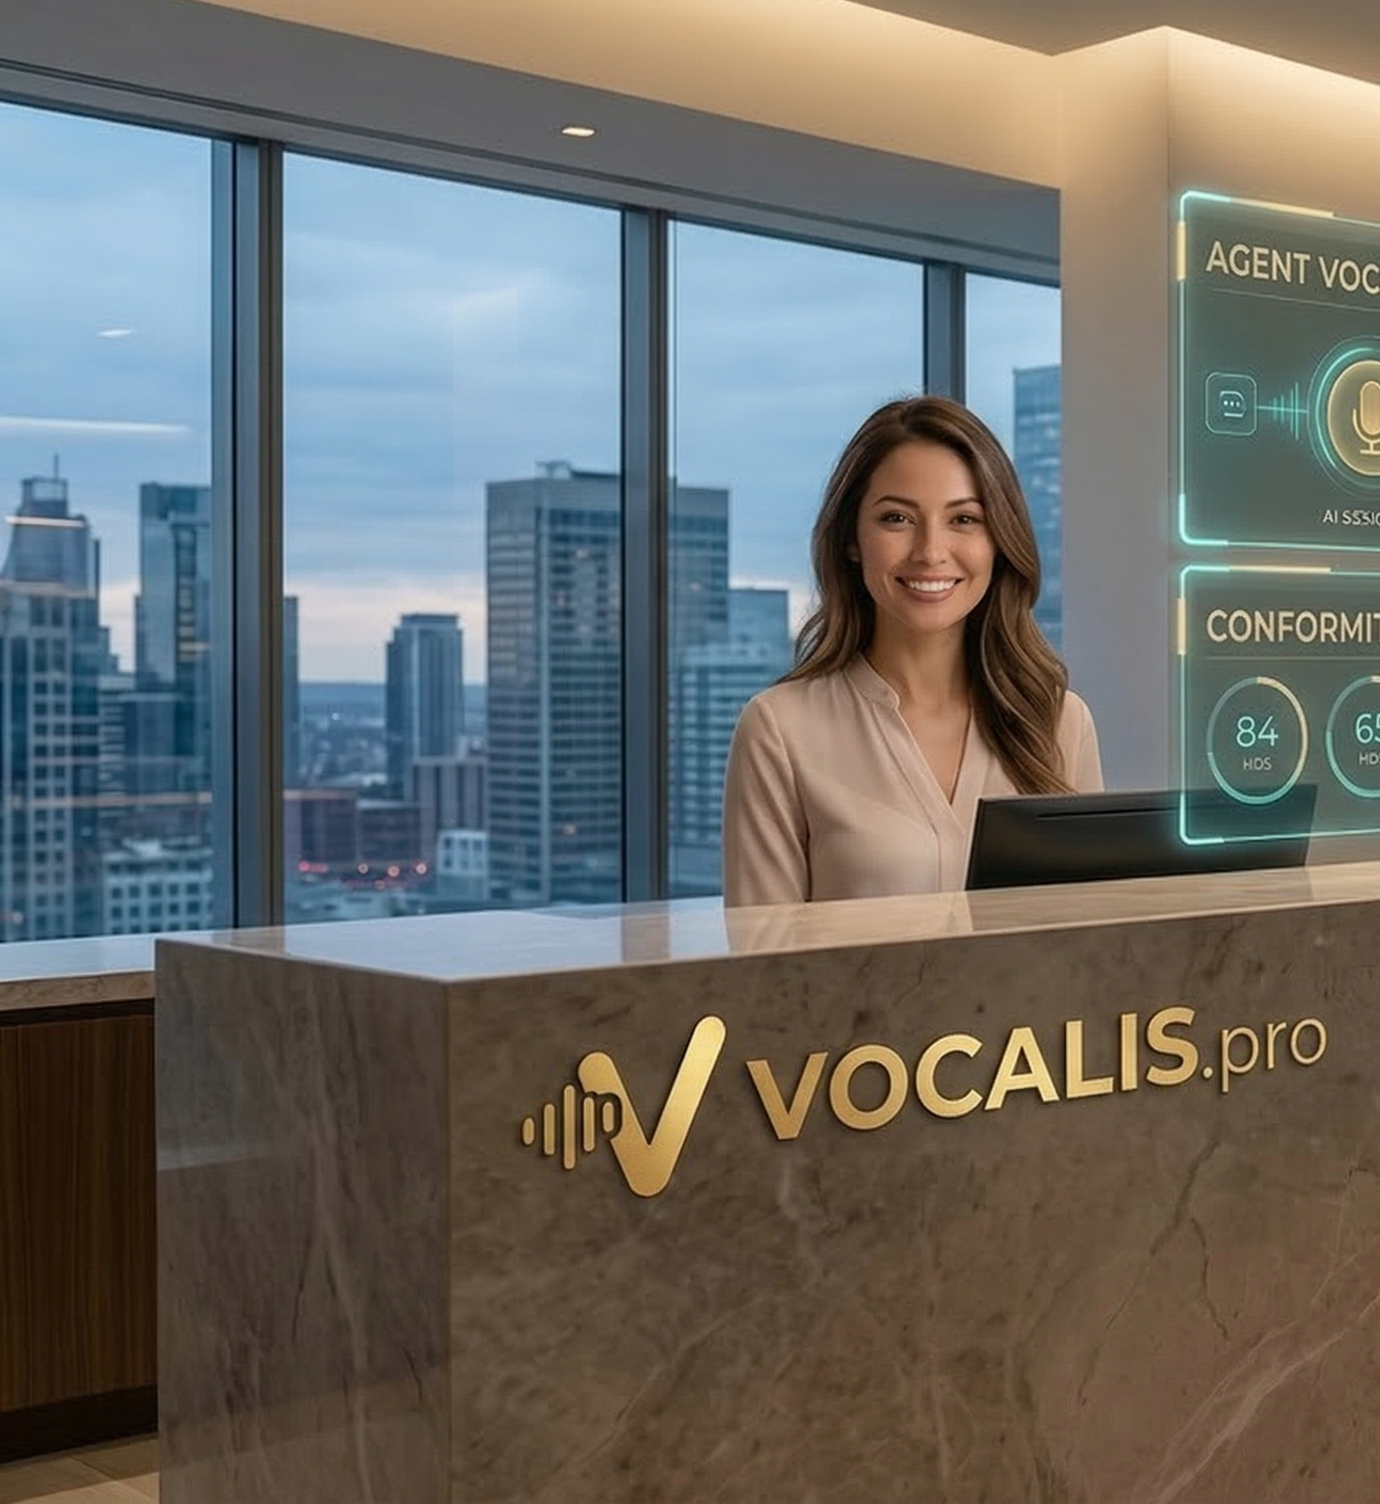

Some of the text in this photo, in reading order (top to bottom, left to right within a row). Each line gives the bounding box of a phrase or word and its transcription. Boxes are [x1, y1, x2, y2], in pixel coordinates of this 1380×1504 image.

[1205, 240, 1311, 285] AGENT
[1322, 509, 1338, 523] AI
[1236, 715, 1279, 748] 84
[1242, 756, 1273, 771] HDS
